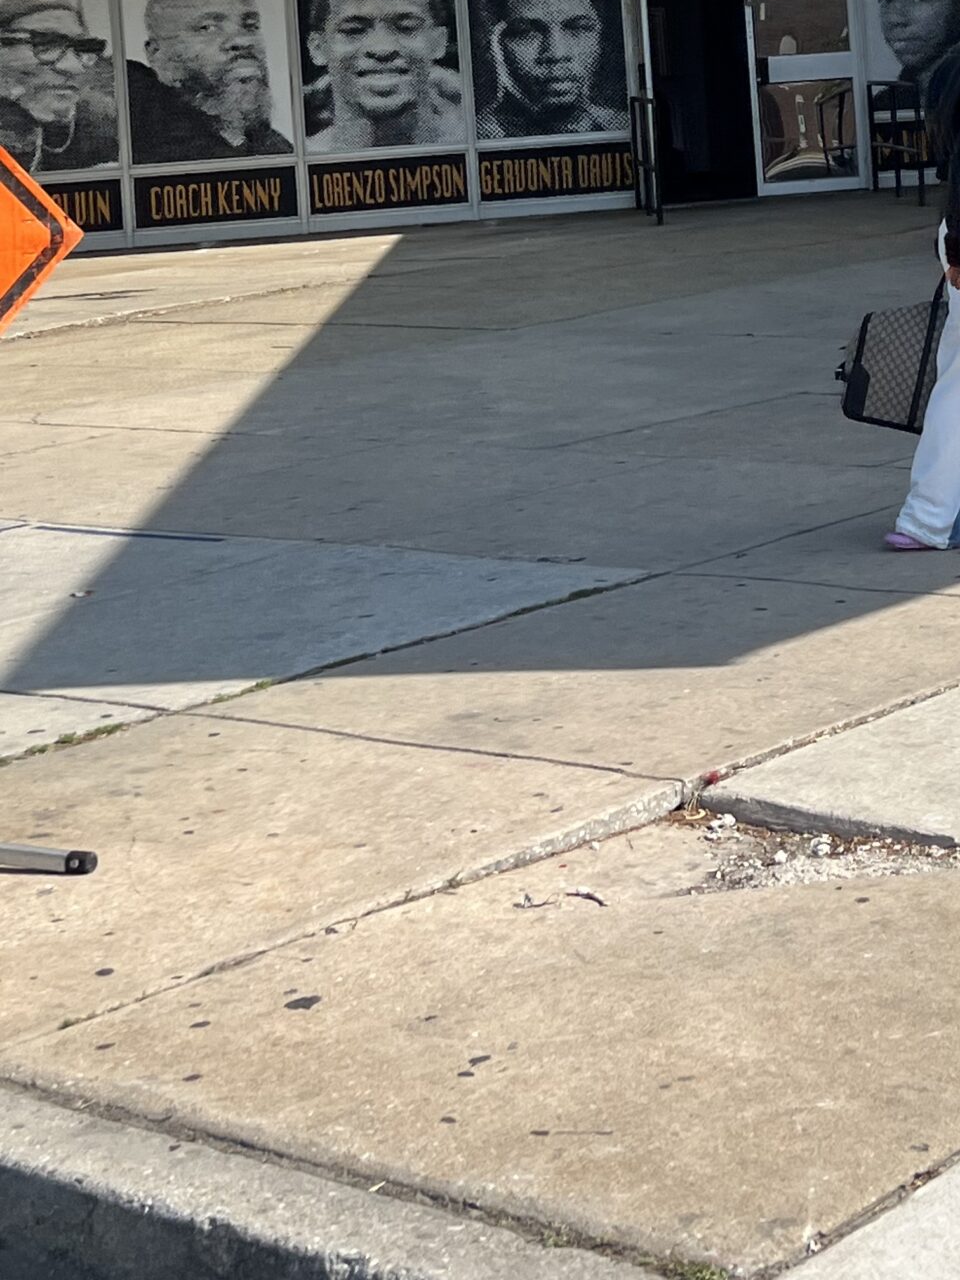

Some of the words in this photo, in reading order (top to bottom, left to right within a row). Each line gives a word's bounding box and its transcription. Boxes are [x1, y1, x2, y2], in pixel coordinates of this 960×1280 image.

[149, 182, 213, 220] COACH
[217, 177, 282, 215] KENNY
[312, 169, 386, 209] LORENZO
[388, 162, 466, 201] SIMPSON
